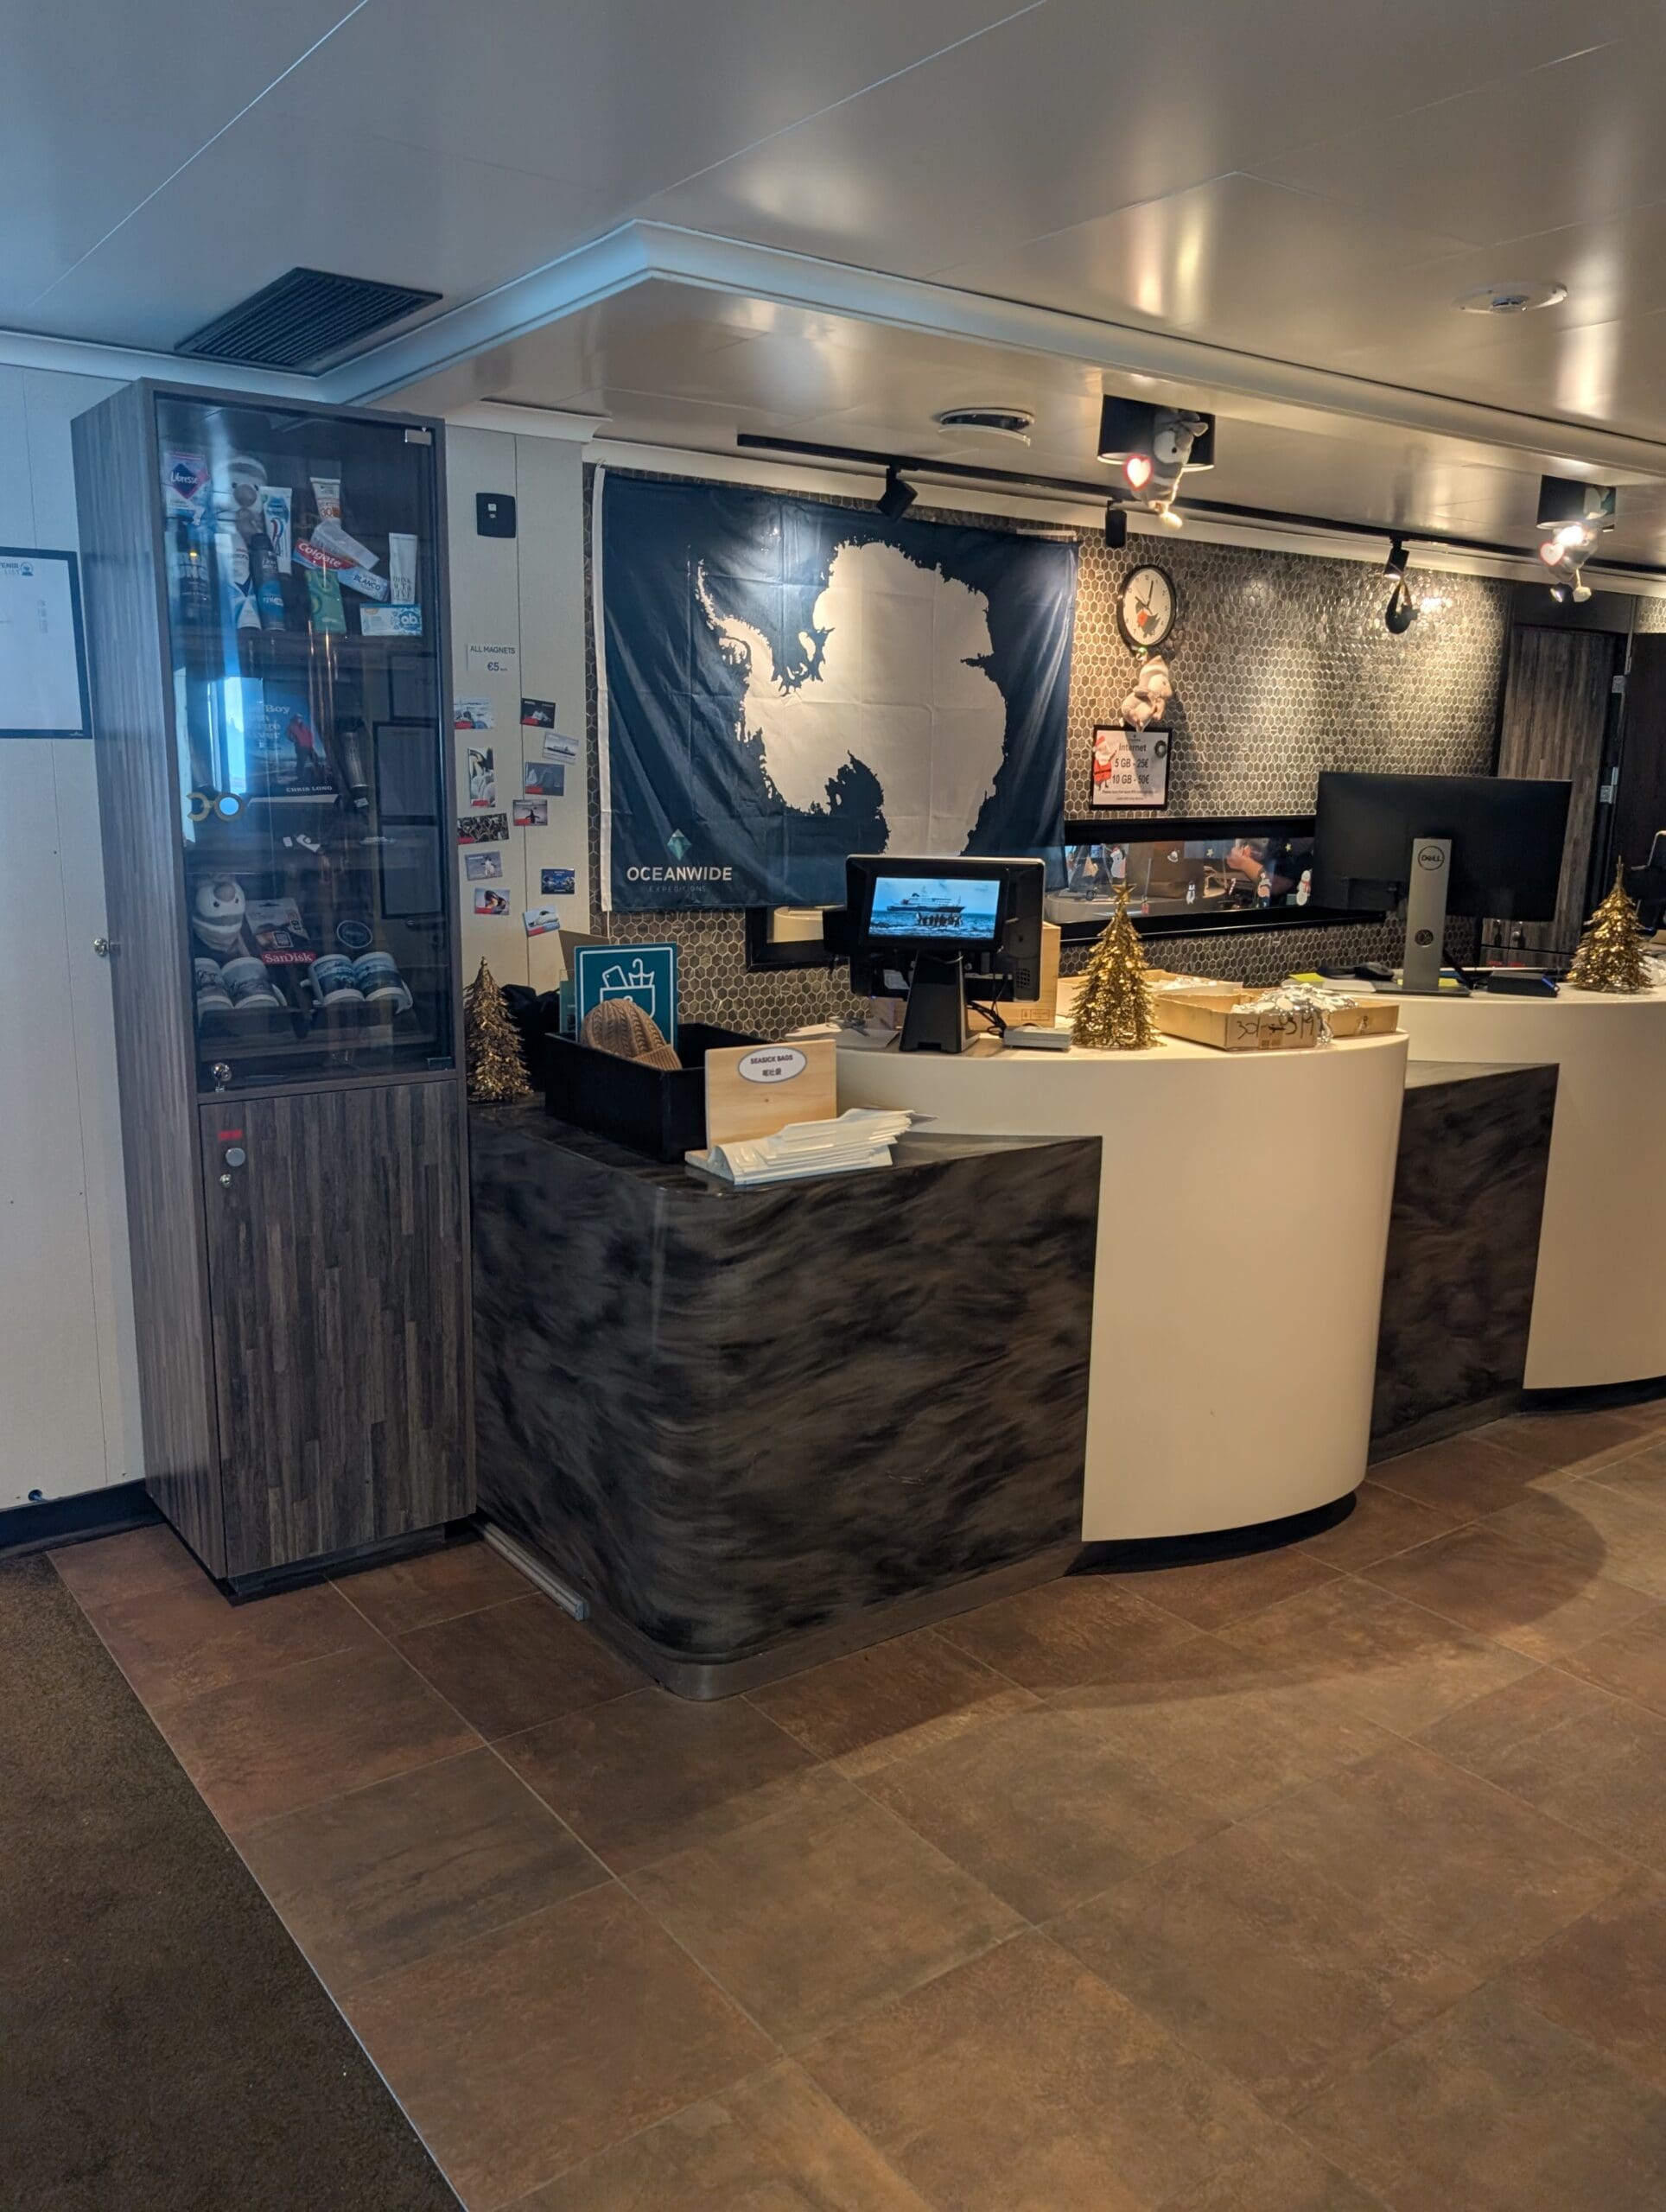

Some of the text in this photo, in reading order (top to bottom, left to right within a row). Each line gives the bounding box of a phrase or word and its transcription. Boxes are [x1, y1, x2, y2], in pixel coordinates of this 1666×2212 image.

[170, 471, 198, 484] Libresse
[298, 543, 341, 567] Colgate
[353, 575, 381, 591] BLANCO
[487, 662, 499, 671] €5
[1119, 743, 1147, 752] Internet
[1115, 758, 1120, 768] 5
[1121, 758, 1131, 768] GB
[1136, 758, 1149, 769] 25€
[1112, 774, 1120, 785] 10
[1121, 774, 1132, 785] GB
[1138, 774, 1150, 785] 50€
[1421, 854, 1441, 862] DELL
[626, 866, 733, 881] OCEANWIDE
[264, 950, 313, 963] SanDisk
[750, 1056, 776, 1065] SEASICK
